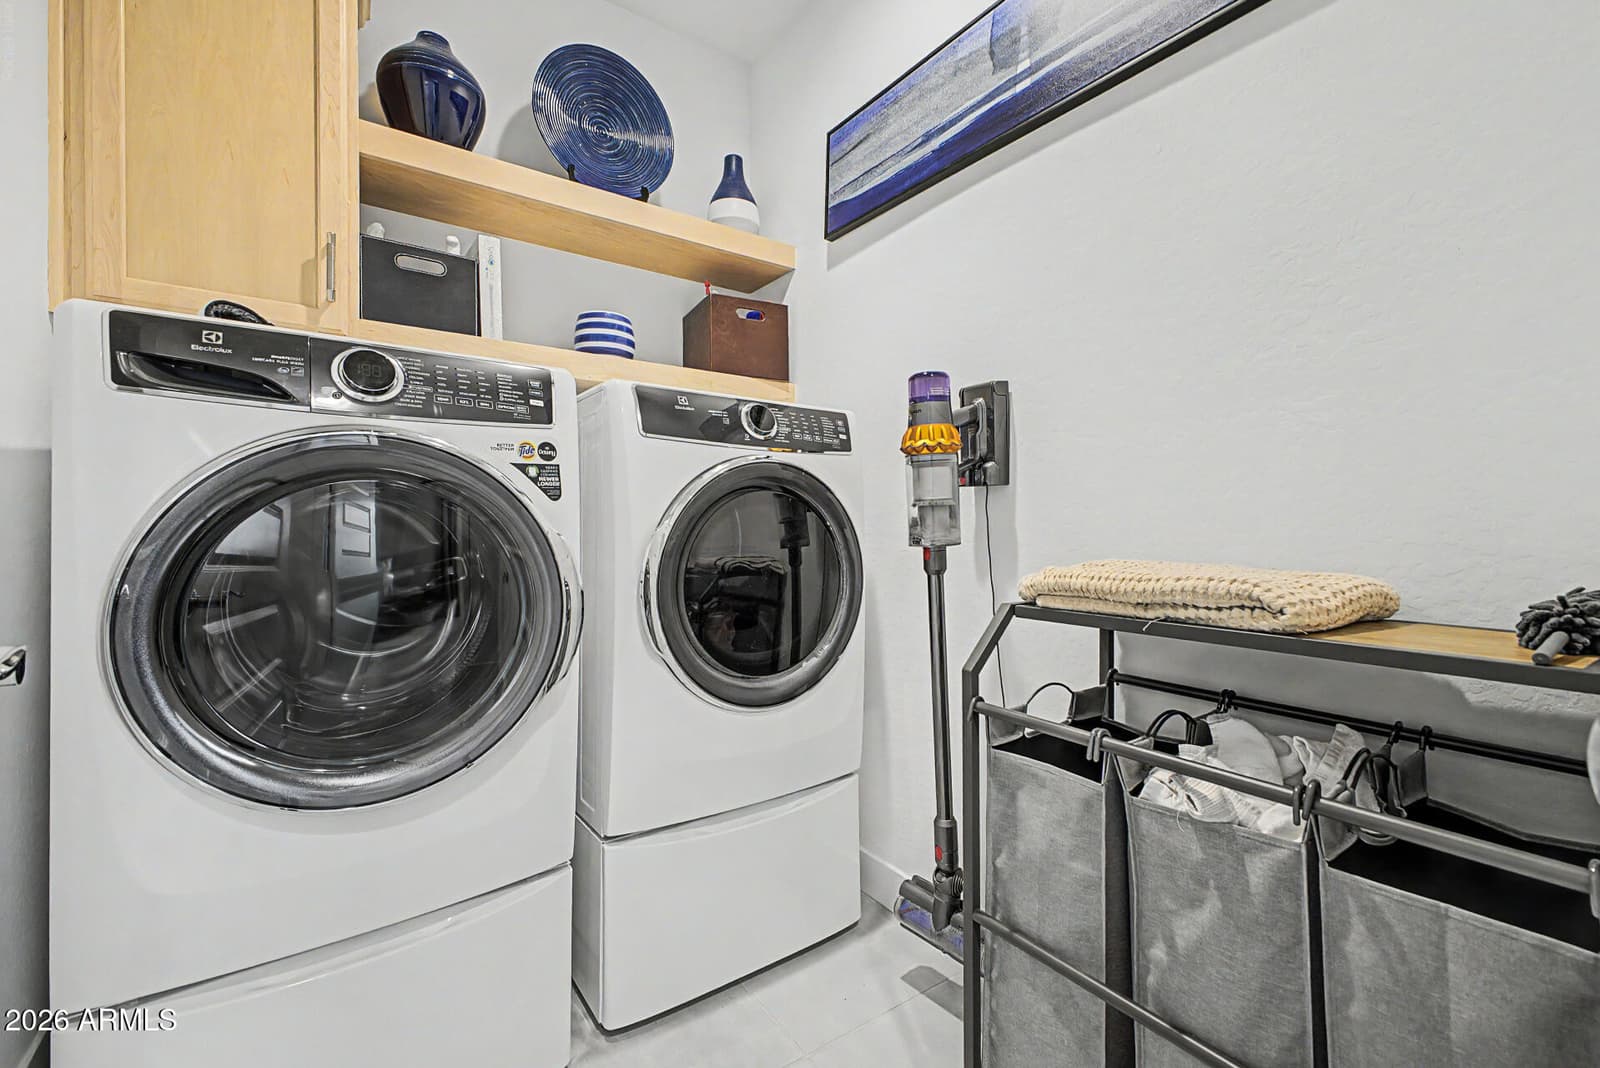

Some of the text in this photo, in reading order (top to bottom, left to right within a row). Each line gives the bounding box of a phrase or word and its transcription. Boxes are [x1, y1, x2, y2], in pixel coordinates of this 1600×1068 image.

[191, 344, 232, 354] Electrolux
[518, 445, 536, 457] Tide
[538, 448, 556, 457] Downy
